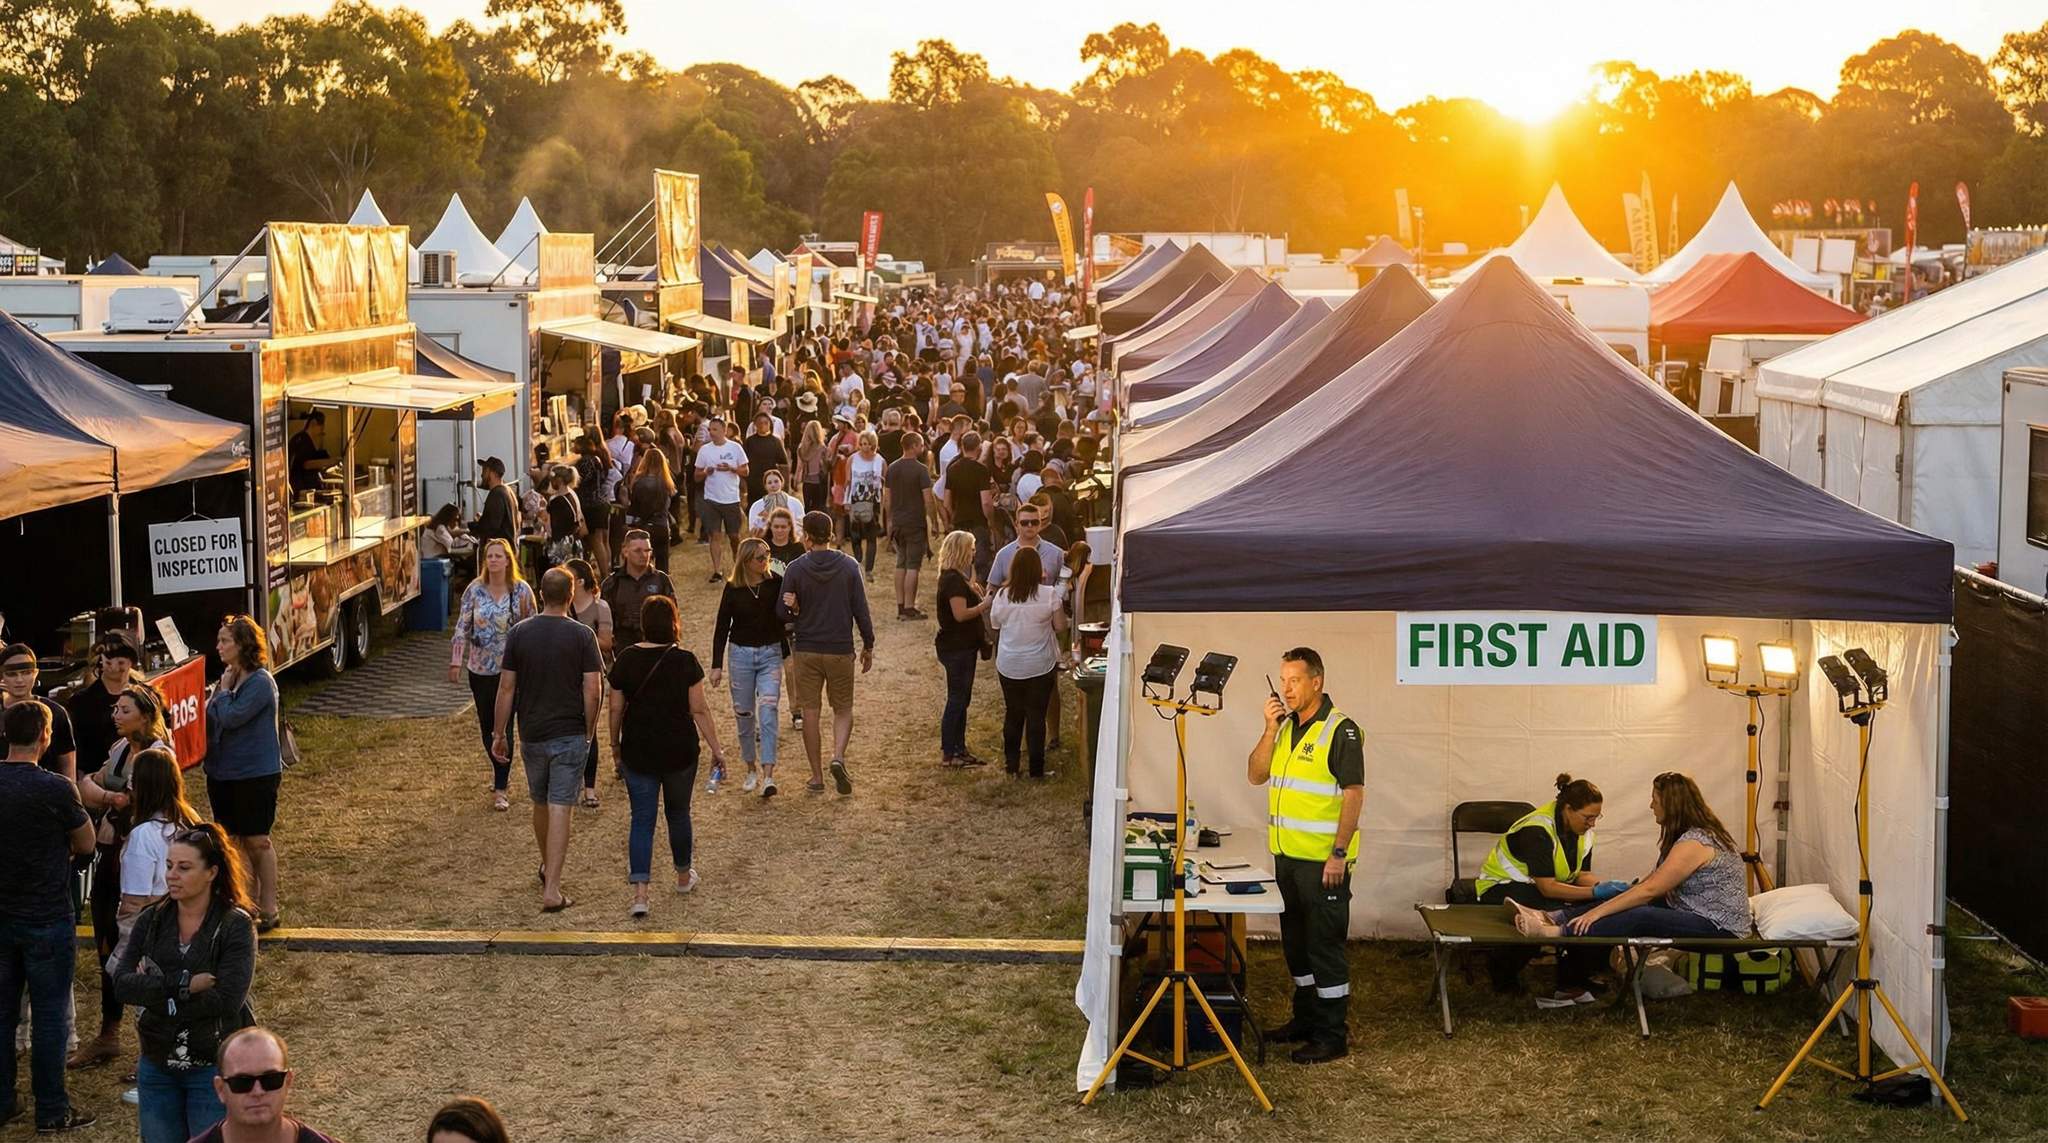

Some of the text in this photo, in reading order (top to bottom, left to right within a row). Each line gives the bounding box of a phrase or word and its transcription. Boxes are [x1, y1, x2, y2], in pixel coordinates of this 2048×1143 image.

[154, 533, 237, 555] CLOSED FOR
[157, 556, 239, 578] INSPECTION
[1409, 622, 1646, 668] FIRST AID
